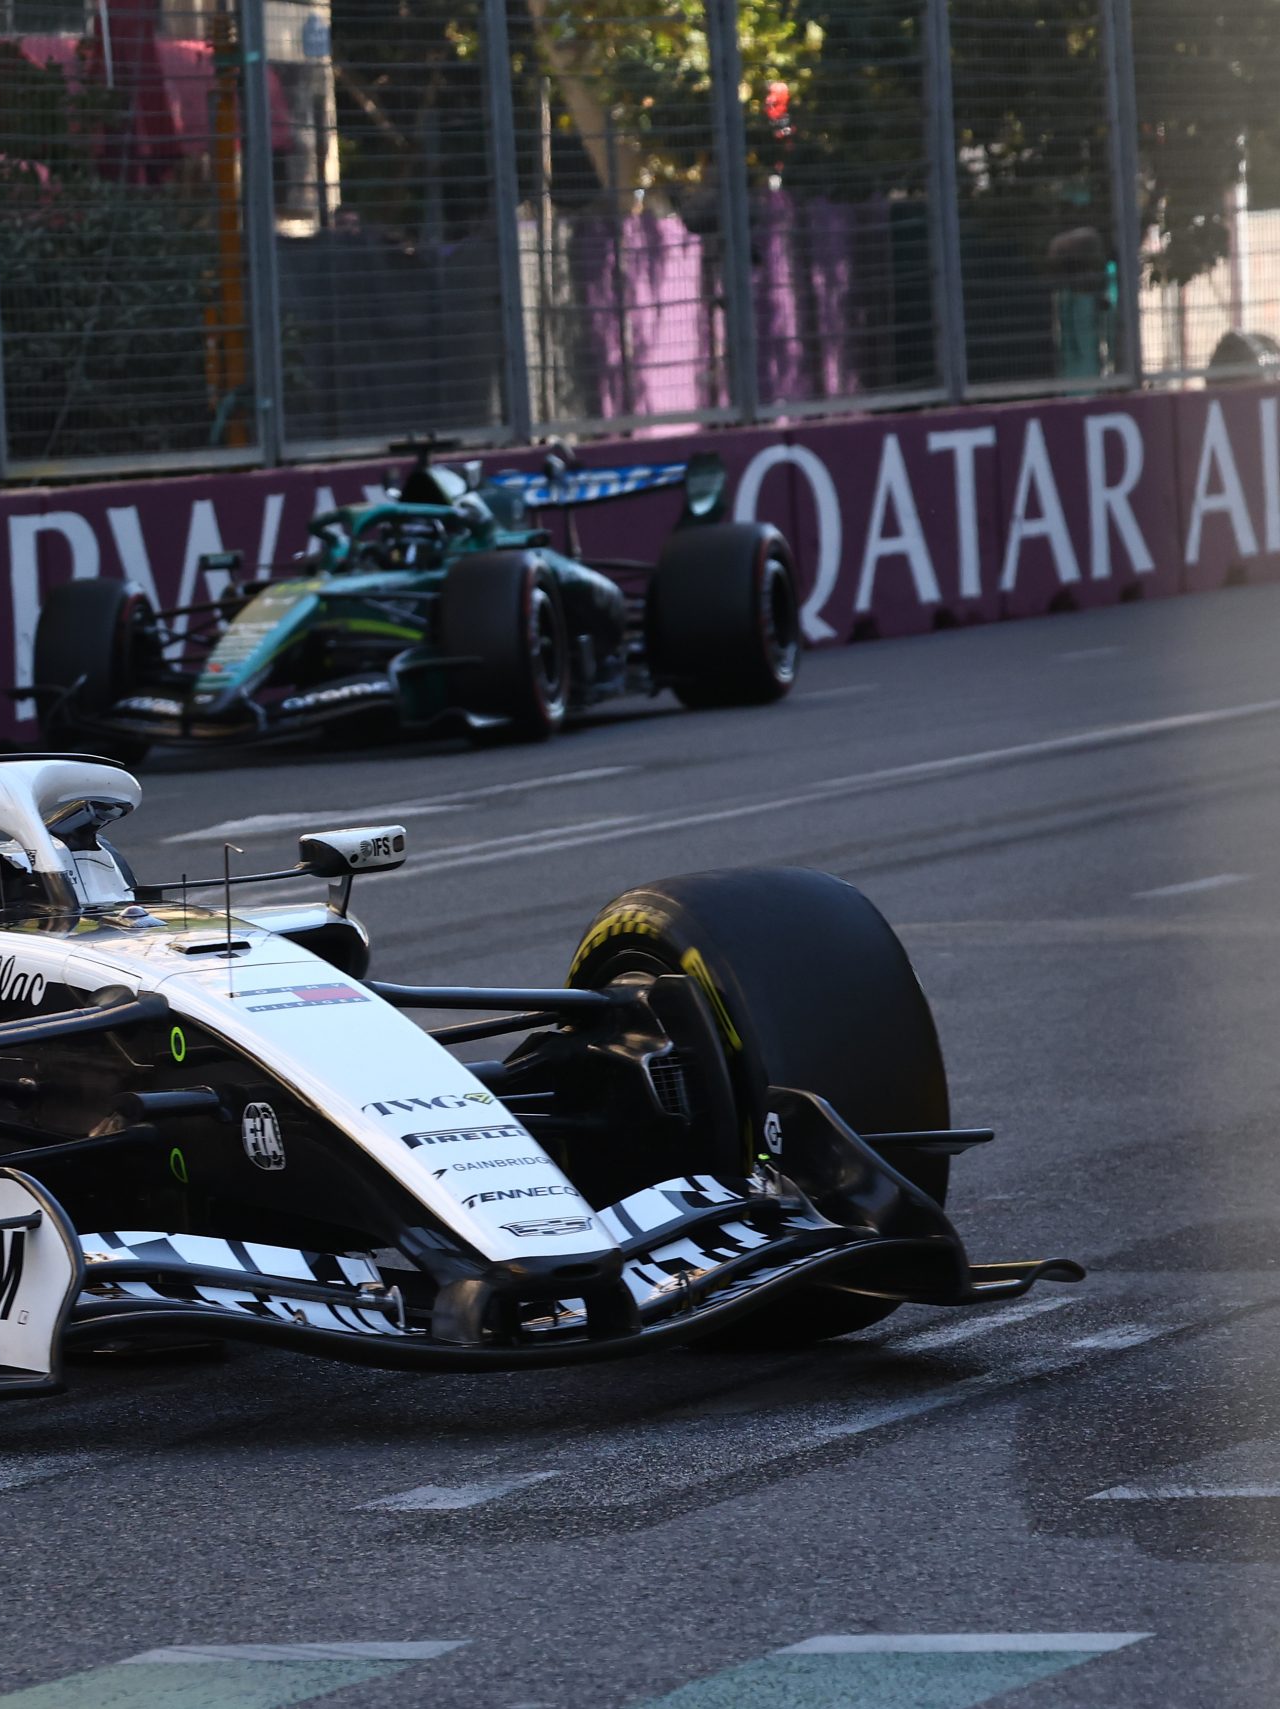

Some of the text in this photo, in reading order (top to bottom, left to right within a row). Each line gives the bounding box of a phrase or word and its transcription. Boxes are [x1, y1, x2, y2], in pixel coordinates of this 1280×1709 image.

[733, 411, 1157, 641] QATAR
[371, 836, 391, 857] IFS
[252, 997, 363, 1012] HILFIGER
[361, 1094, 467, 1117] TWG
[244, 1117, 284, 1157] FIA
[401, 1124, 529, 1150] PIRELLI
[461, 1185, 581, 1210] TENNECO
